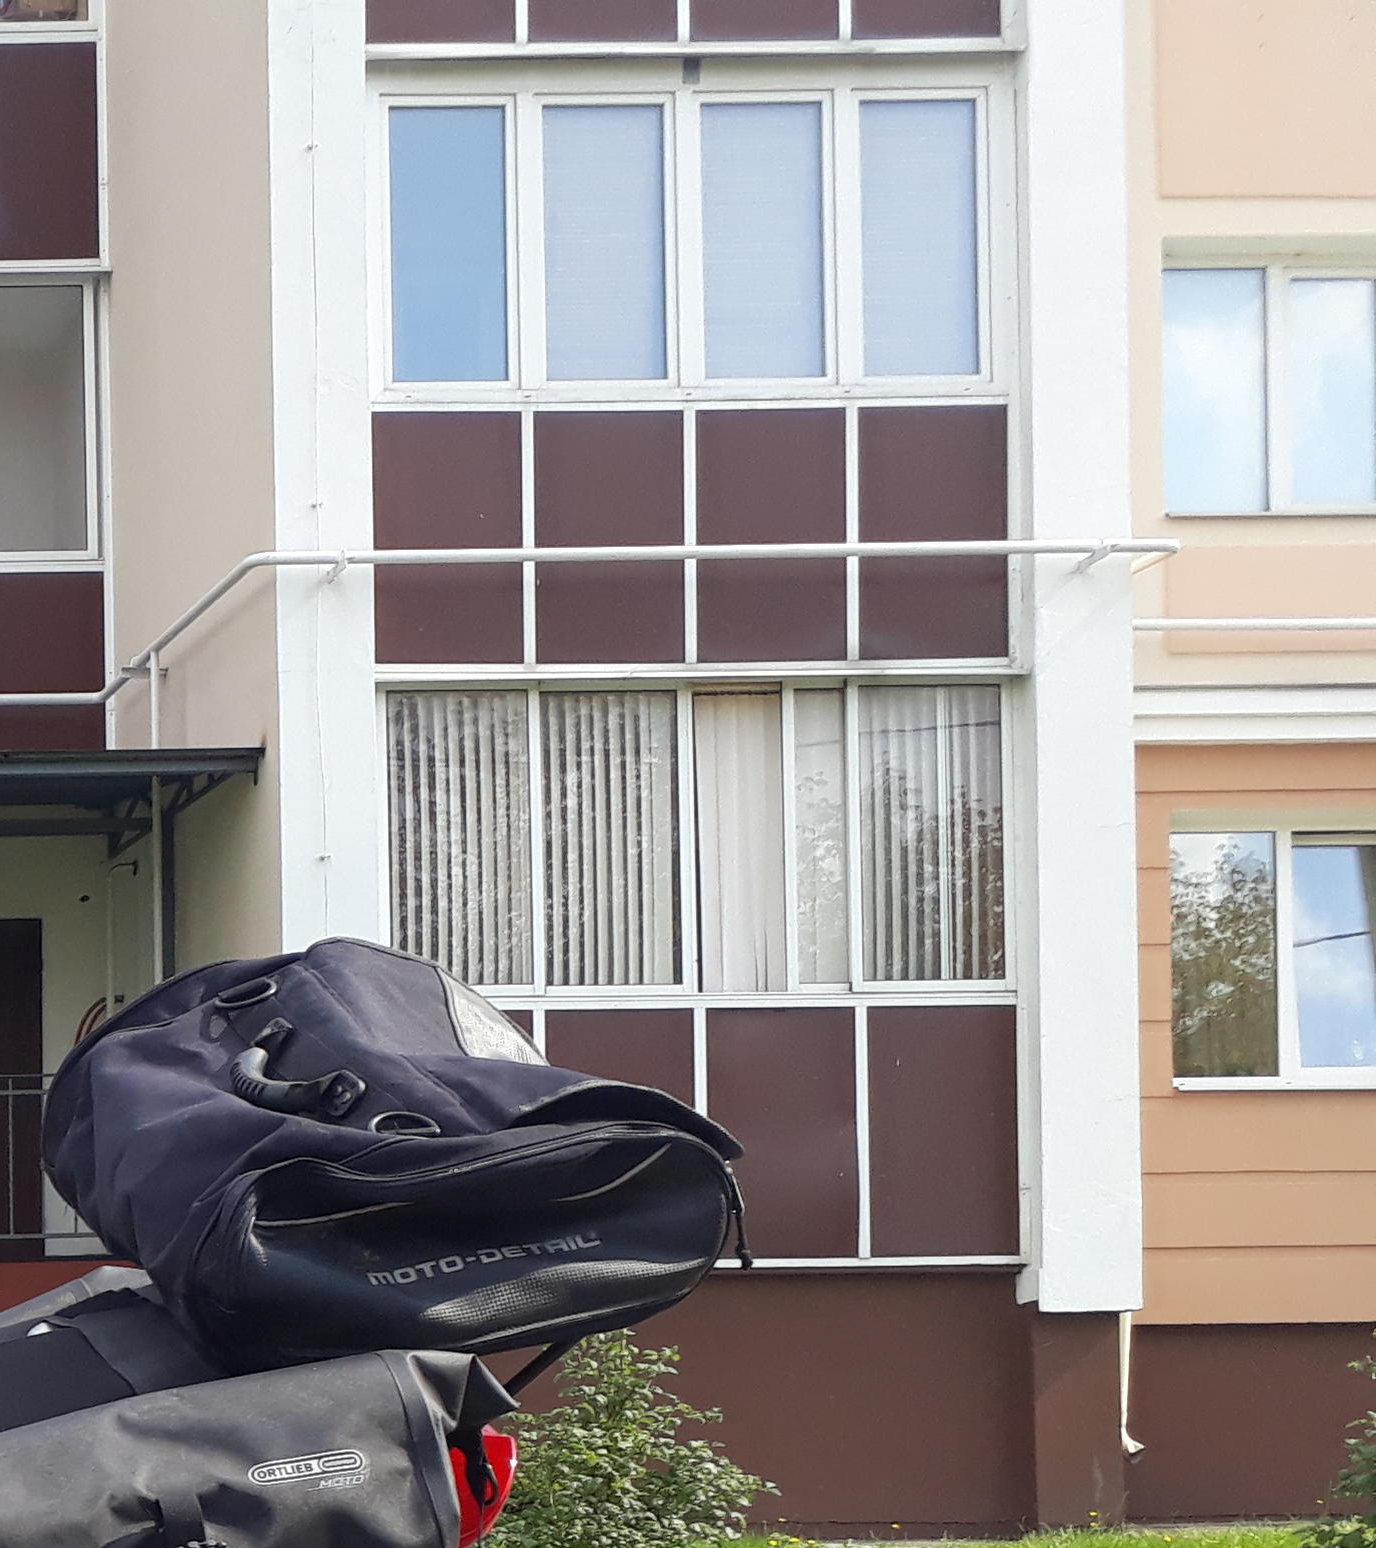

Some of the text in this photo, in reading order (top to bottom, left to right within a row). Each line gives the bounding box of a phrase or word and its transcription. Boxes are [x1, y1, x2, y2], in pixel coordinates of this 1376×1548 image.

[366, 1233, 601, 1287] MOTO-DETAIL
[257, 1462, 314, 1480] ORTLIEB
[318, 1475, 365, 1489] MOTO
